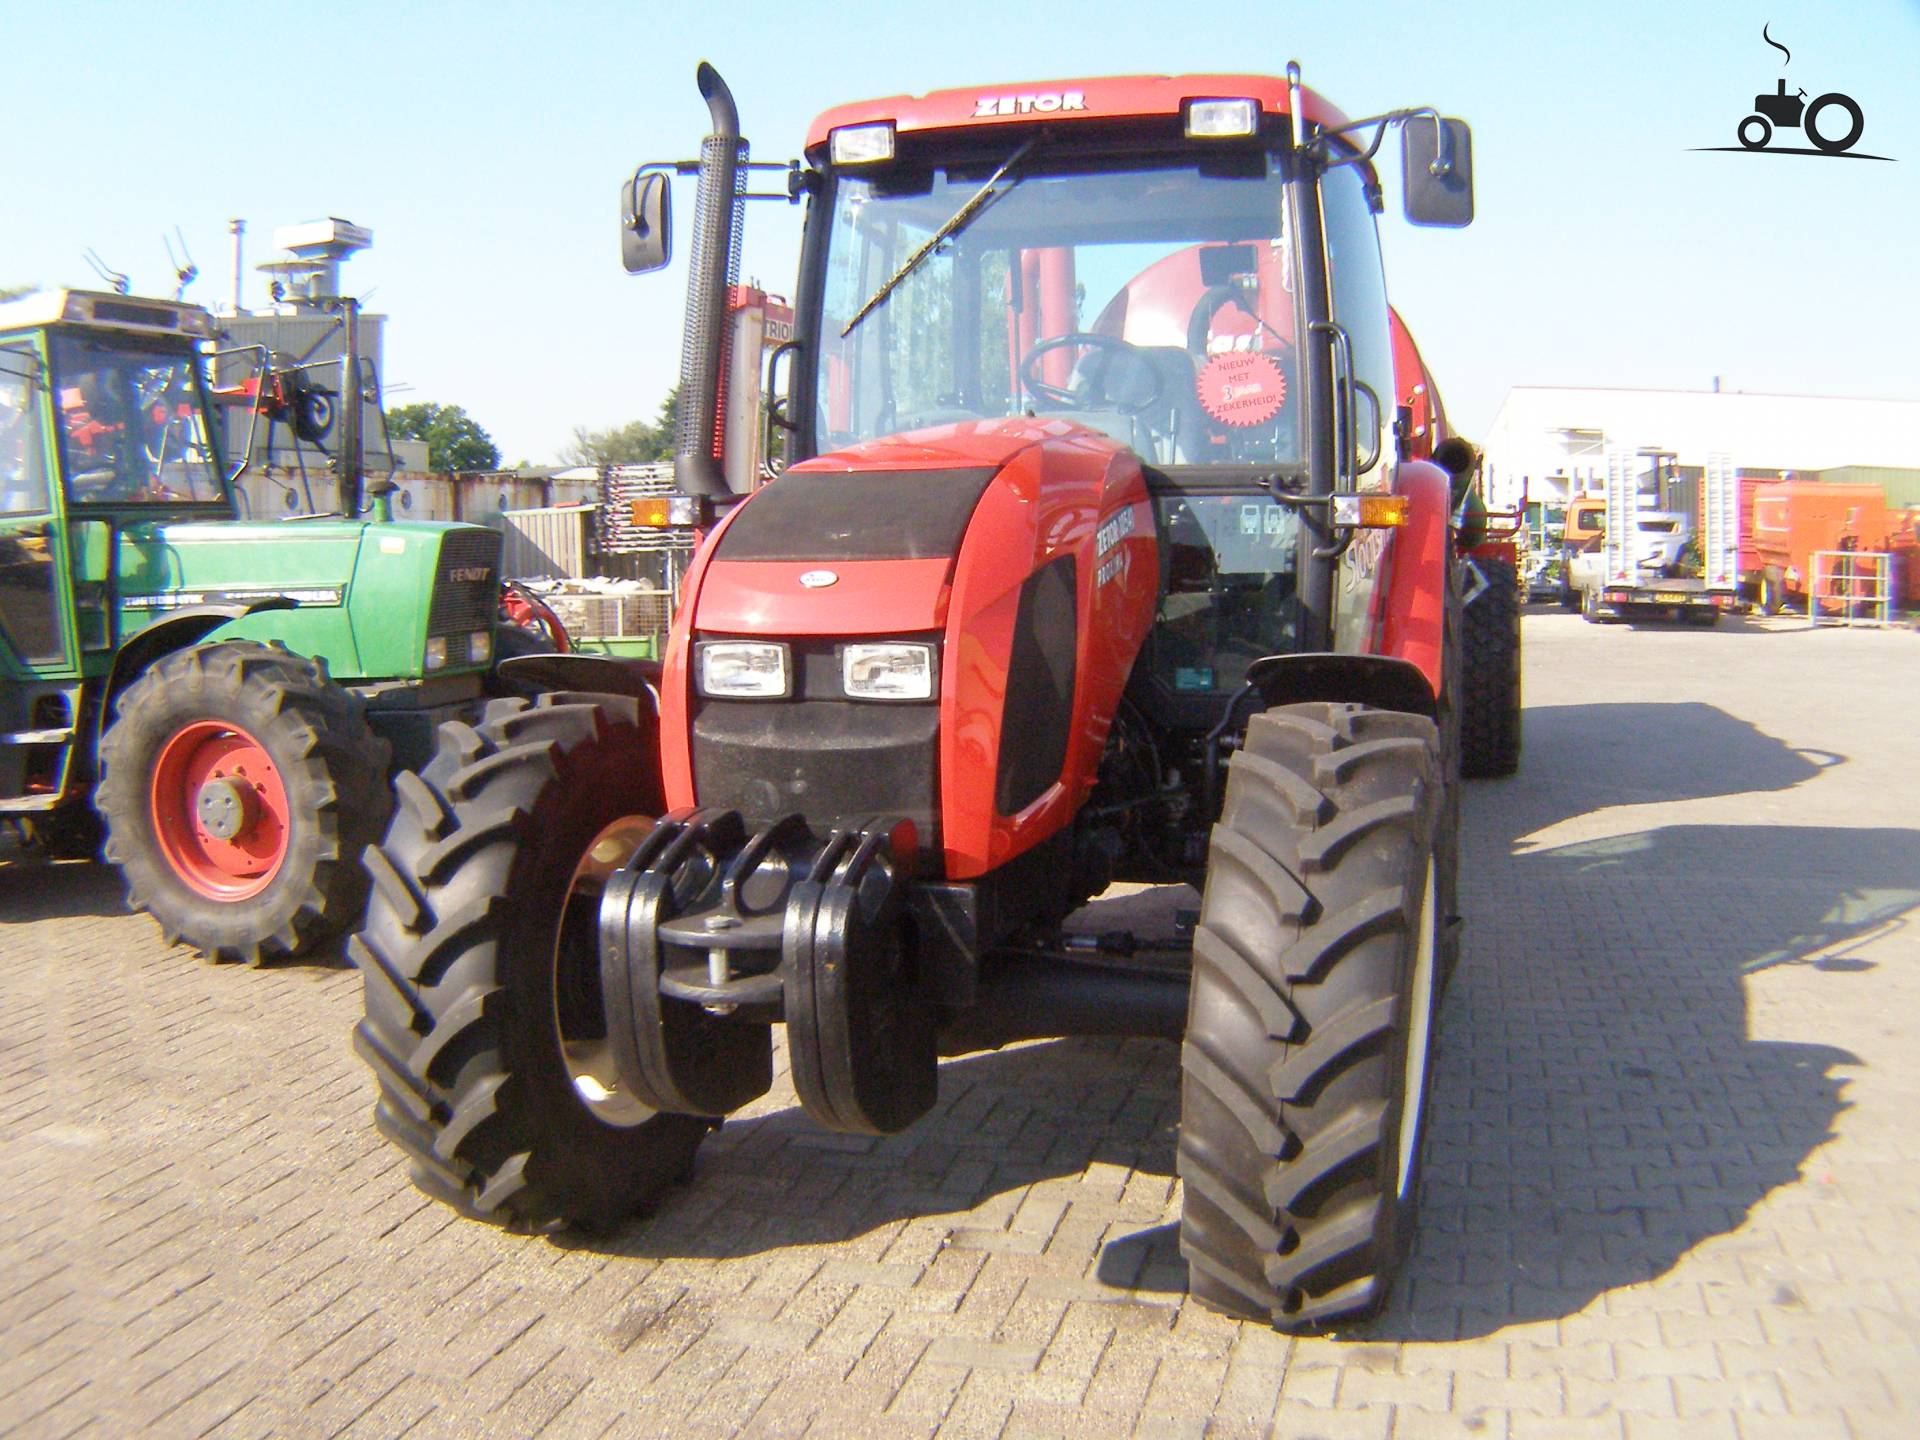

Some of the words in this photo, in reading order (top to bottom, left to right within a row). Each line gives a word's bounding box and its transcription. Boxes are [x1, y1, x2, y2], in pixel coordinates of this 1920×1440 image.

[970, 91, 1088, 117] ZETOR
[1218, 357, 1255, 372] NIEUW
[1228, 372, 1250, 384] MET
[1221, 385, 1233, 402] 3
[1216, 394, 1278, 414] ZEKERHEID!
[450, 567, 490, 582] FENDT
